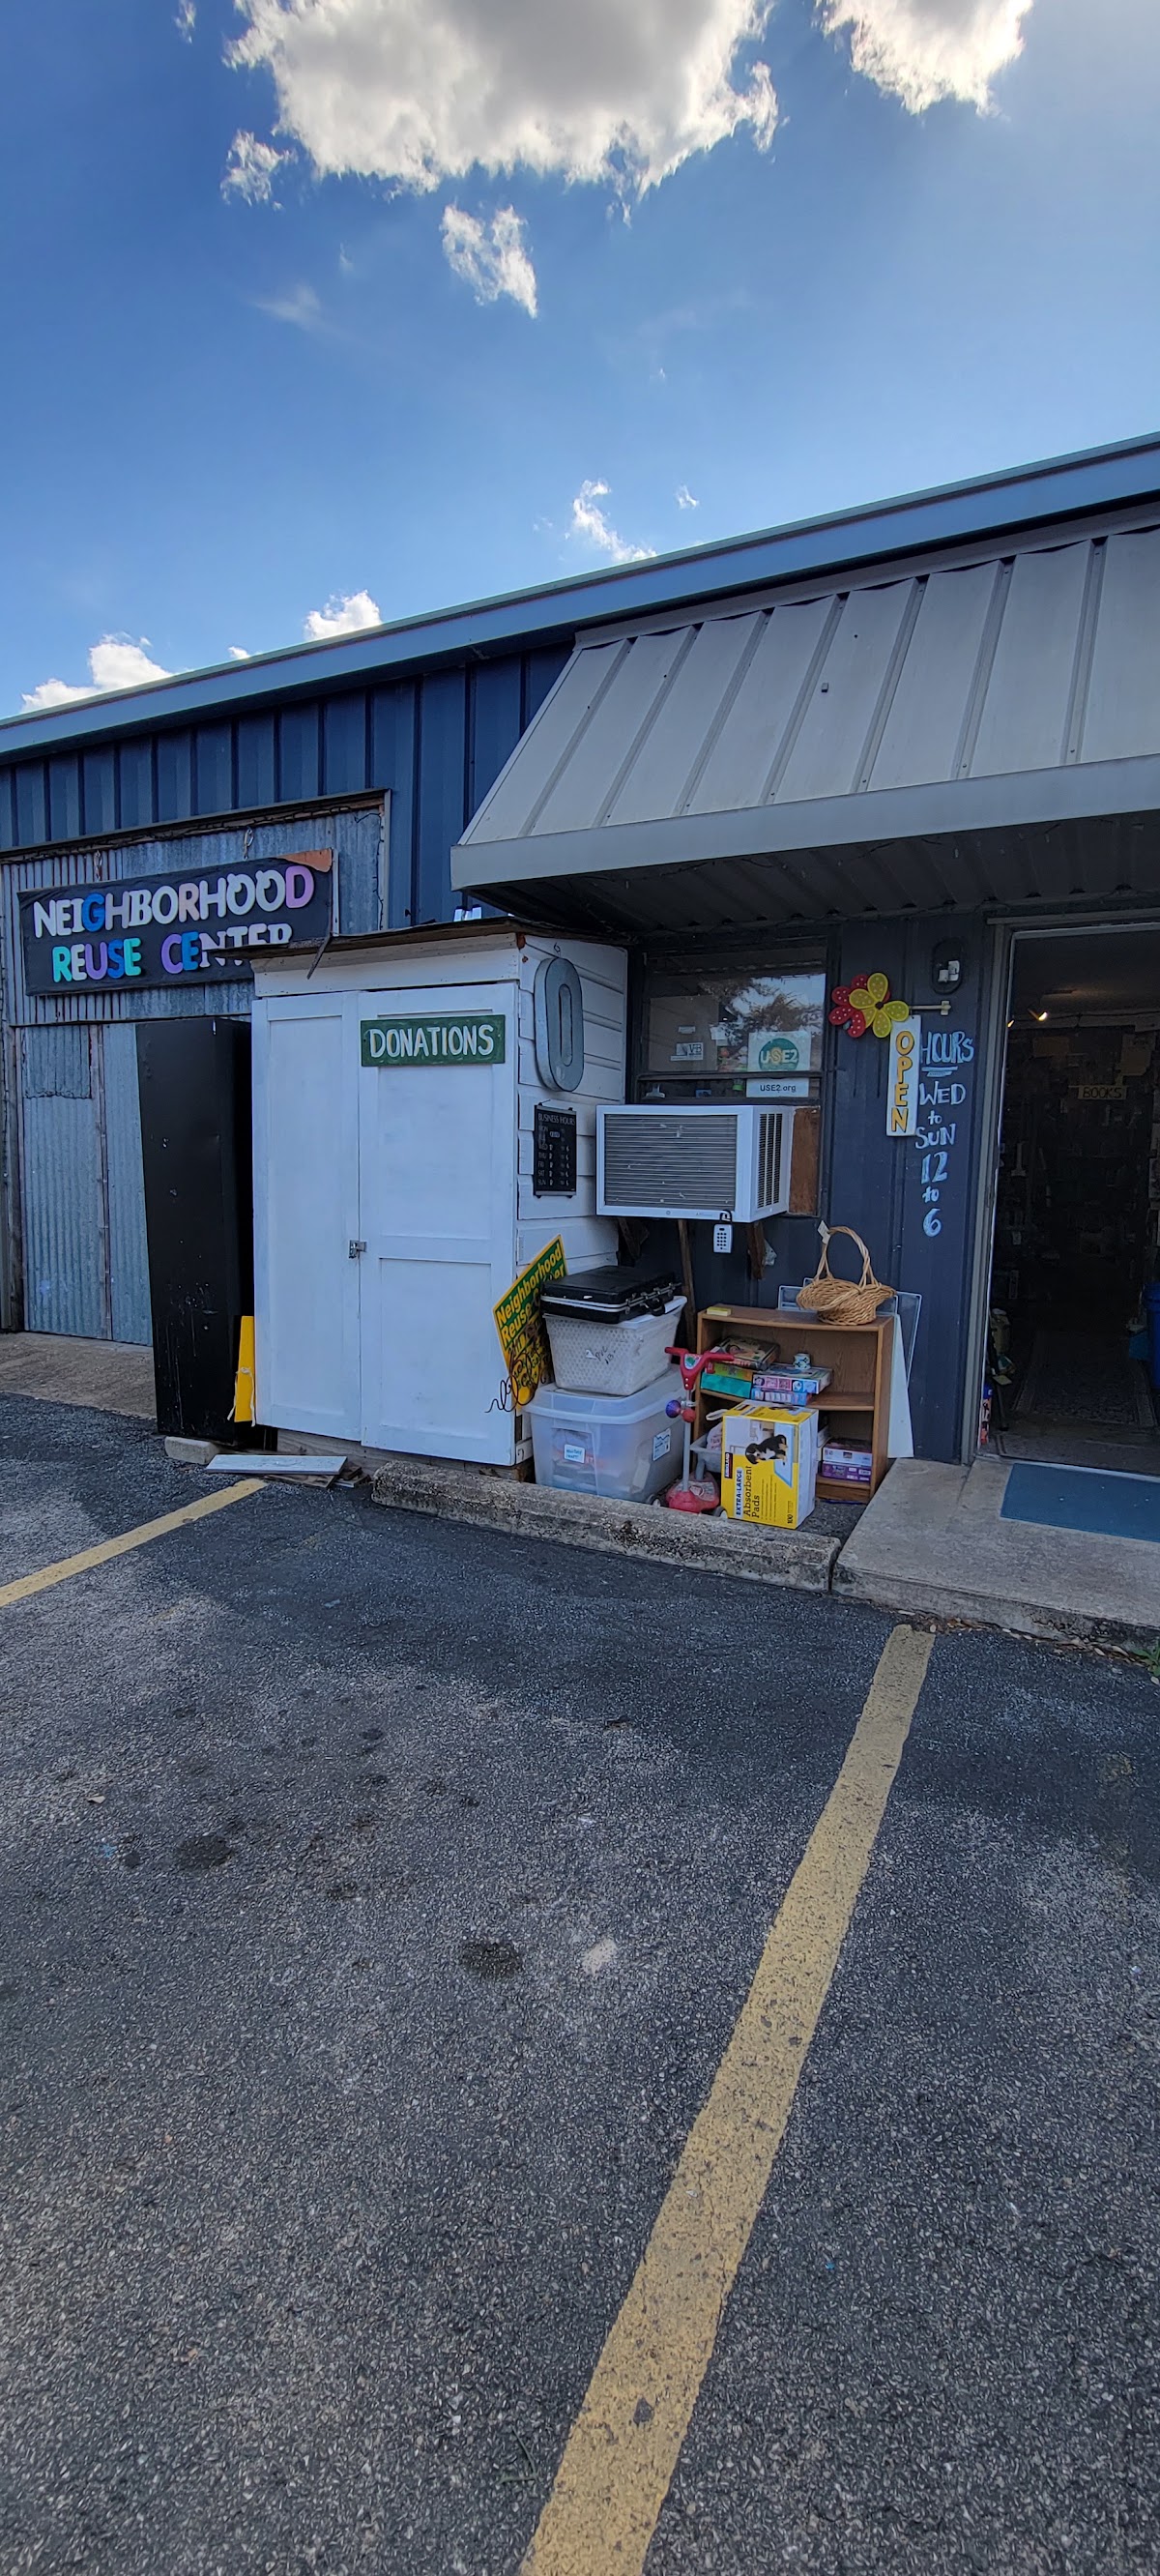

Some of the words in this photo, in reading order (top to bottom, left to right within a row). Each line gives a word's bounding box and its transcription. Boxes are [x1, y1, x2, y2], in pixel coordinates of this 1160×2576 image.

[34, 865, 315, 939] NEIGHBORHOOD
[52, 938, 142, 982] REUSE
[369, 1024, 495, 1058] DONATIONS
[920, 1031, 974, 1065] HOURS
[760, 1047, 798, 1065] USE2
[760, 1083, 797, 1094] USE2.org
[890, 1030, 915, 1133] OPEN
[918, 1080, 967, 1106] WED
[1083, 1086, 1122, 1099] BOOKS
[537, 1113, 560, 1124] BUSINESS
[560, 1116, 575, 1127] HOURS
[927, 1110, 942, 1125] to
[914, 1123, 956, 1150] SUN
[920, 1152, 948, 1185] 12
[922, 1186, 940, 1203] to
[922, 1208, 942, 1237] 6
[497, 1243, 563, 1328] Neighborhood
[502, 1303, 532, 1346] Reuse
[743, 1465, 752, 1517] Absorbent
[751, 1495, 760, 1518] Pads
